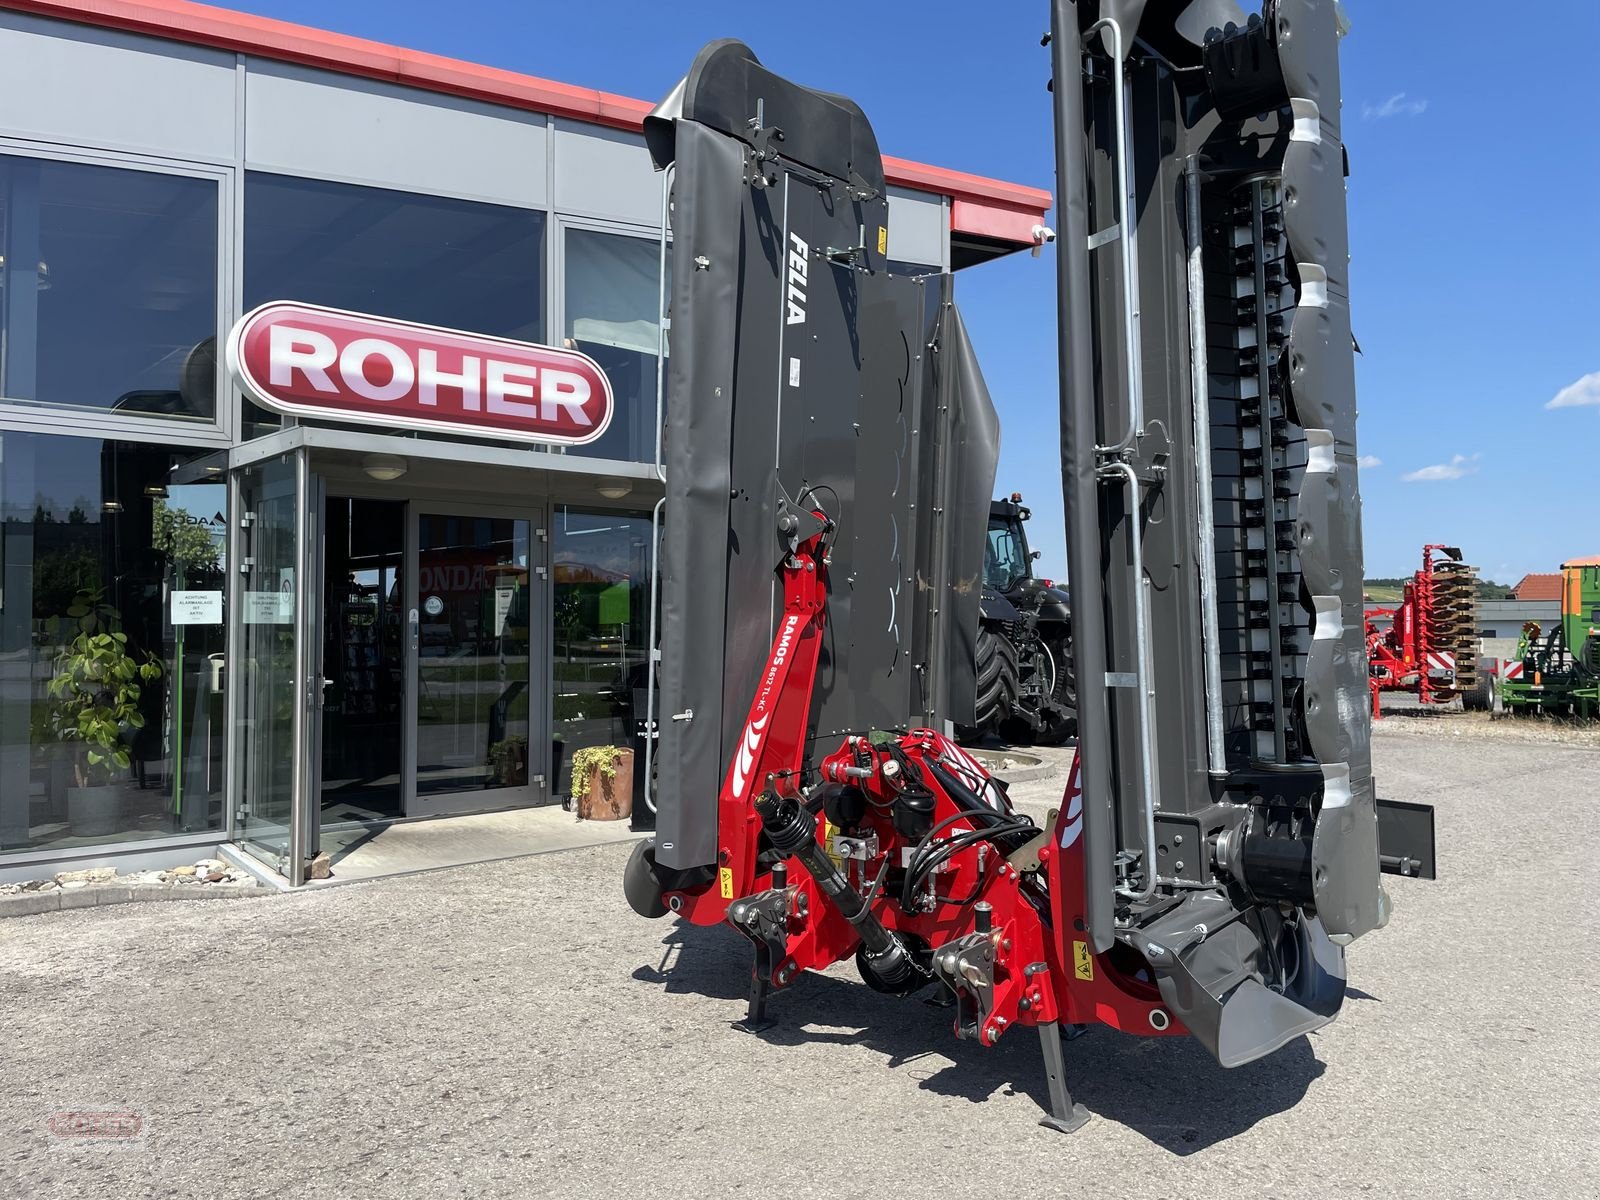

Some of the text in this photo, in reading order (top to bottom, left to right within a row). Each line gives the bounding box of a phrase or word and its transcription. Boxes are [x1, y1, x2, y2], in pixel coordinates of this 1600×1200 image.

[787, 232, 808, 325] FELLA
[270, 324, 593, 427] ROHER
[419, 564, 491, 592] ONDA
[773, 615, 799, 666] RAMOS
[756, 687, 771, 712] TL-KC
